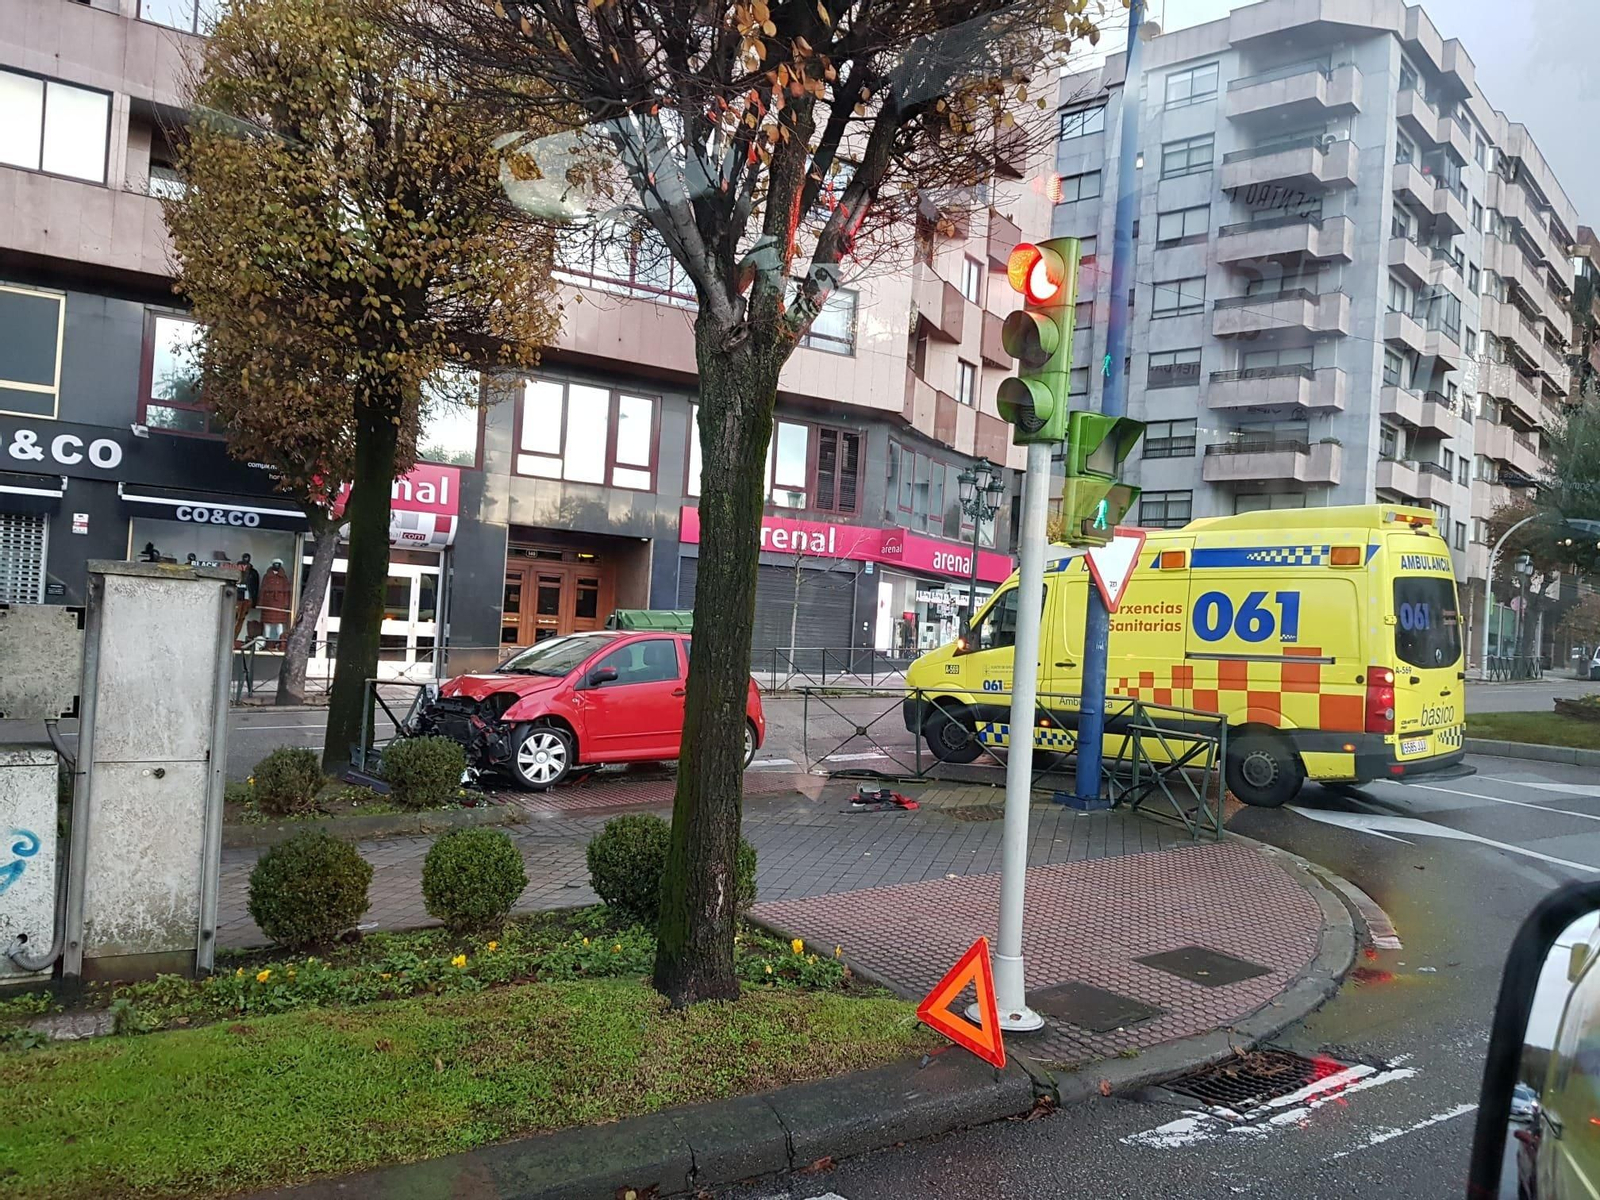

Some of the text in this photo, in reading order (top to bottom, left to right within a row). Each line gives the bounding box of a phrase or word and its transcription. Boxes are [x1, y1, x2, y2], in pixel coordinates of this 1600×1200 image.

[0, 429, 123, 469] &CO
[176, 506, 260, 527] CO&CO
[760, 526, 836, 553] renal
[881, 543, 902, 554] arenal
[933, 551, 974, 575] arenal
[1401, 555, 1450, 571] AMBULANCIA
[1119, 601, 1183, 614] rxencias
[1192, 591, 1301, 643] 061
[1400, 603, 1430, 631] 061
[1108, 618, 1182, 632] Sanitarias
[983, 680, 1003, 691] 061
[1421, 702, 1455, 727] básico
